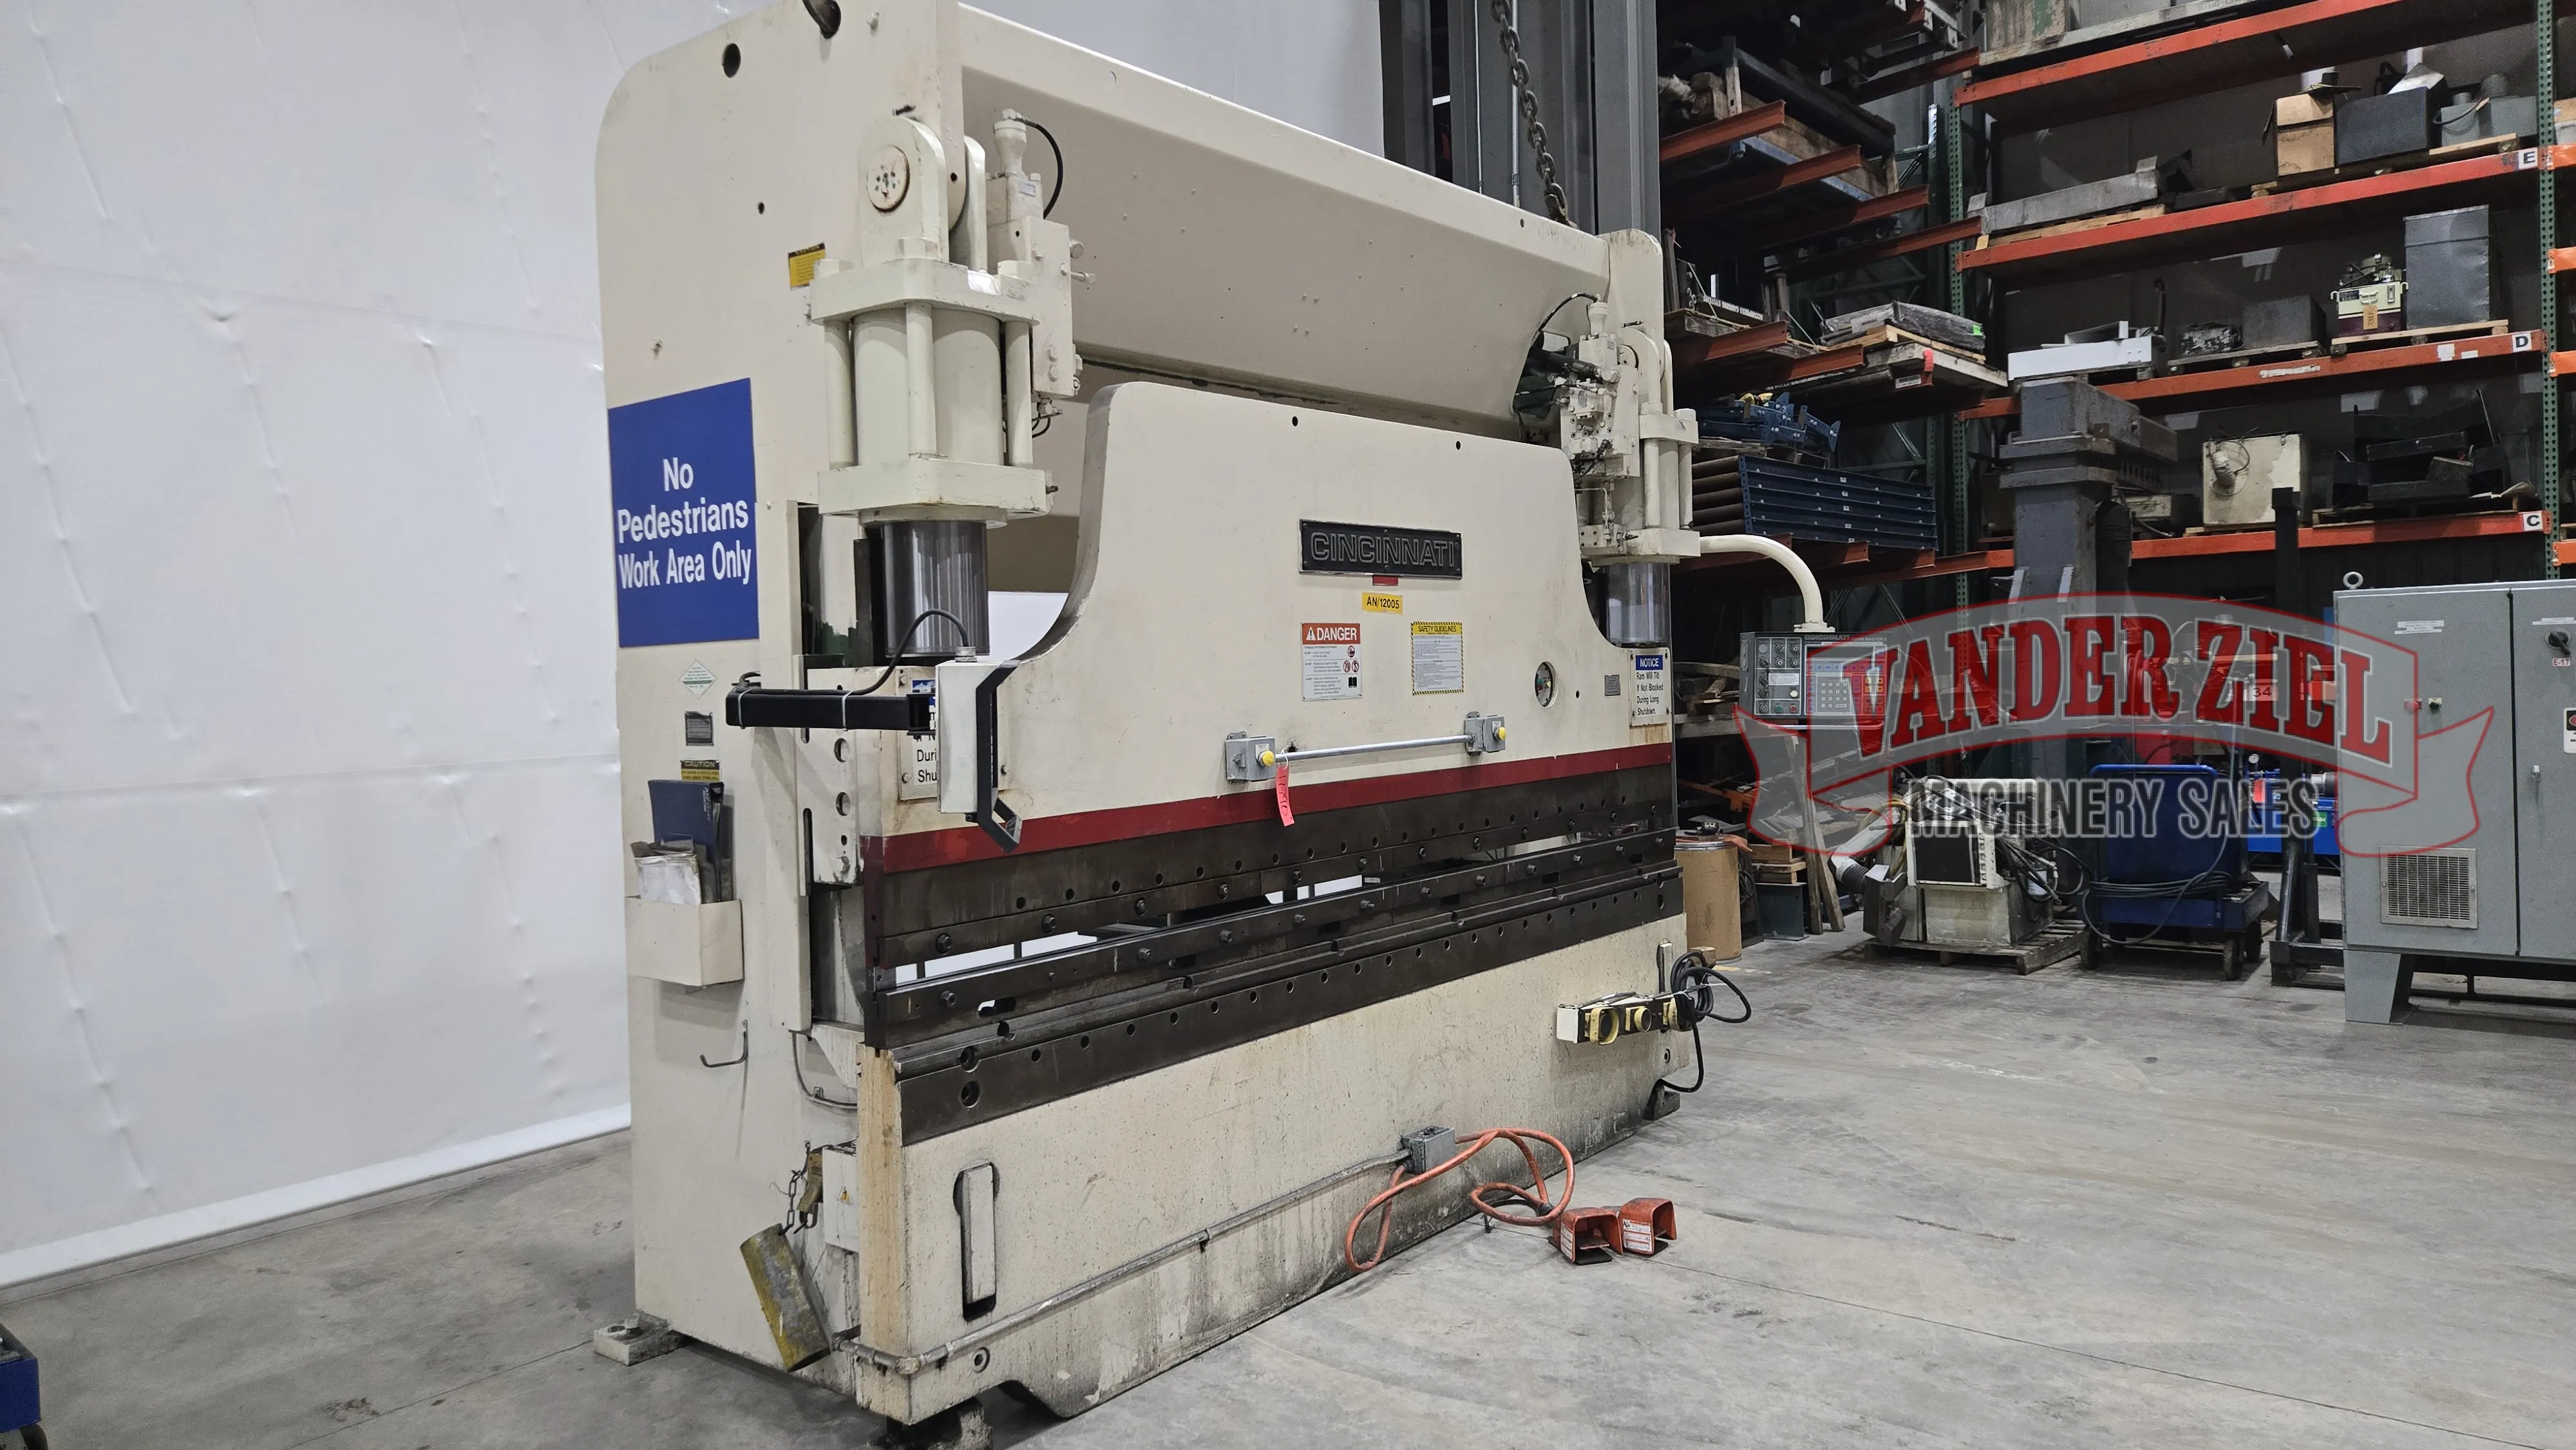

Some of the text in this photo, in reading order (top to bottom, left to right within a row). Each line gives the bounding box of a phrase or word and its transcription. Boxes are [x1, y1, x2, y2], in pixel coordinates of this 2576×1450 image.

[2523, 151, 2535, 164] E
[2515, 335, 2528, 348] D
[663, 457, 694, 491] No
[617, 497, 749, 543] Pedestrians
[2526, 514, 2540, 527] C
[1311, 532, 1455, 567] CINCINNATI
[618, 540, 752, 589] Work Area Only
[1367, 596, 1400, 610] AN/12005
[1316, 626, 1357, 641] DANGER
[1640, 658, 1660, 668] NOTICE
[1636, 672, 1645, 680] Ram
[1636, 684, 1640, 692] If
[2253, 686, 2272, 697] 34
[1636, 695, 1659, 704] During Long
[1637, 708, 1656, 716] Shutdown.
[917, 748, 937, 762] Duri
